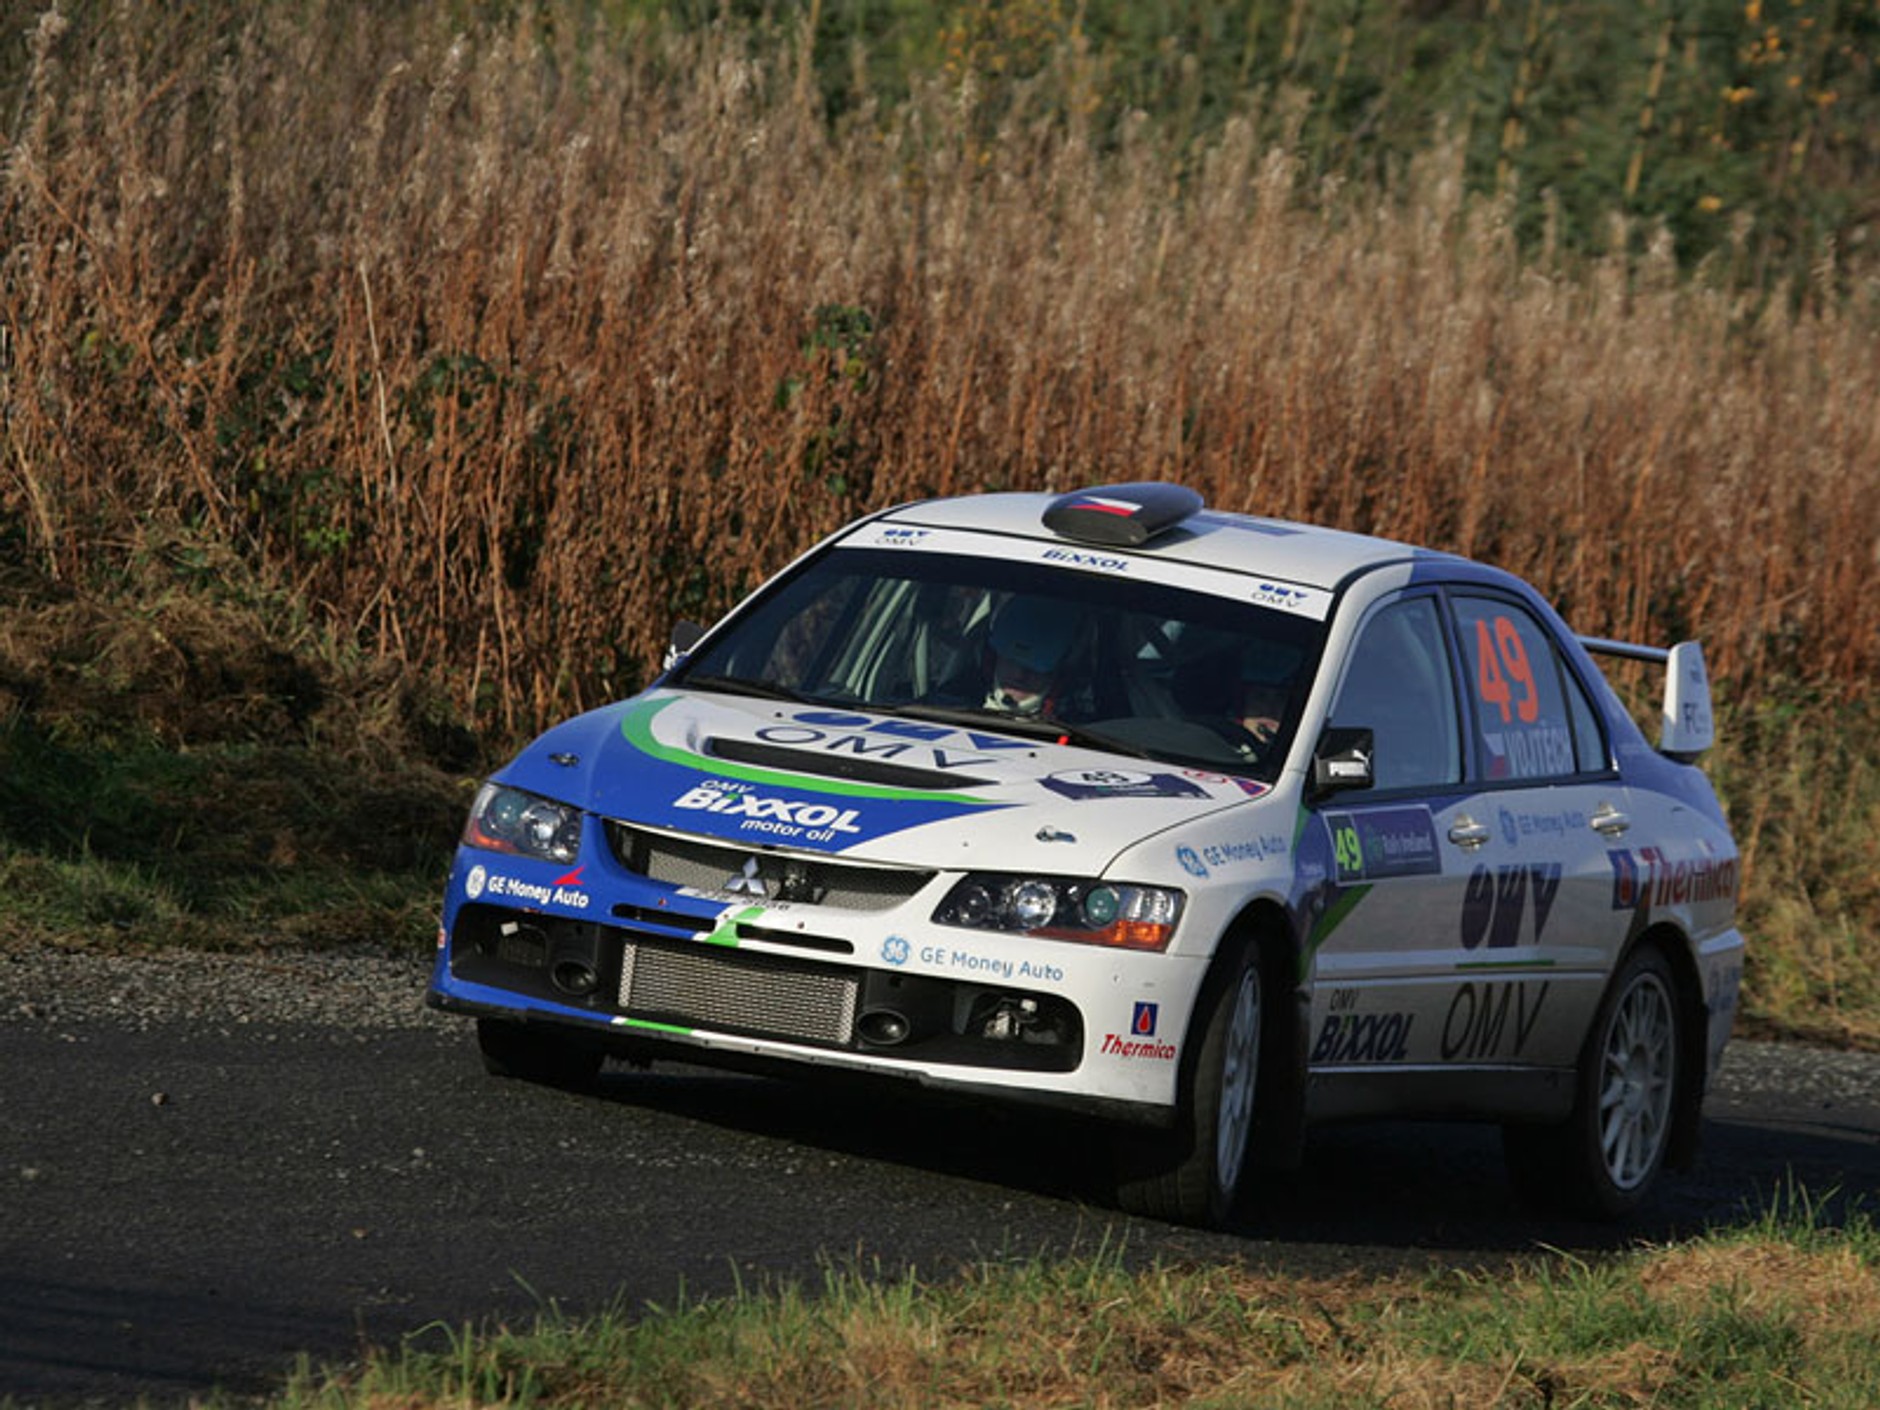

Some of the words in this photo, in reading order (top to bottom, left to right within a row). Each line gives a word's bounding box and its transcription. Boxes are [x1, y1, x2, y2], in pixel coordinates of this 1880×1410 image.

[1475, 616, 1539, 724] 49
[755, 726, 1000, 769] OMV
[701, 780, 755, 793] OMV
[740, 820, 803, 837] motor
[806, 829, 836, 842] oil
[1337, 827, 1362, 871] 49
[488, 876, 506, 894] GE
[506, 879, 551, 905] Money
[552, 886, 589, 908] Auto
[921, 947, 945, 965] GE
[951, 951, 1013, 978] Money
[1019, 960, 1063, 981] Auto
[1440, 980, 1549, 1060] OMV
